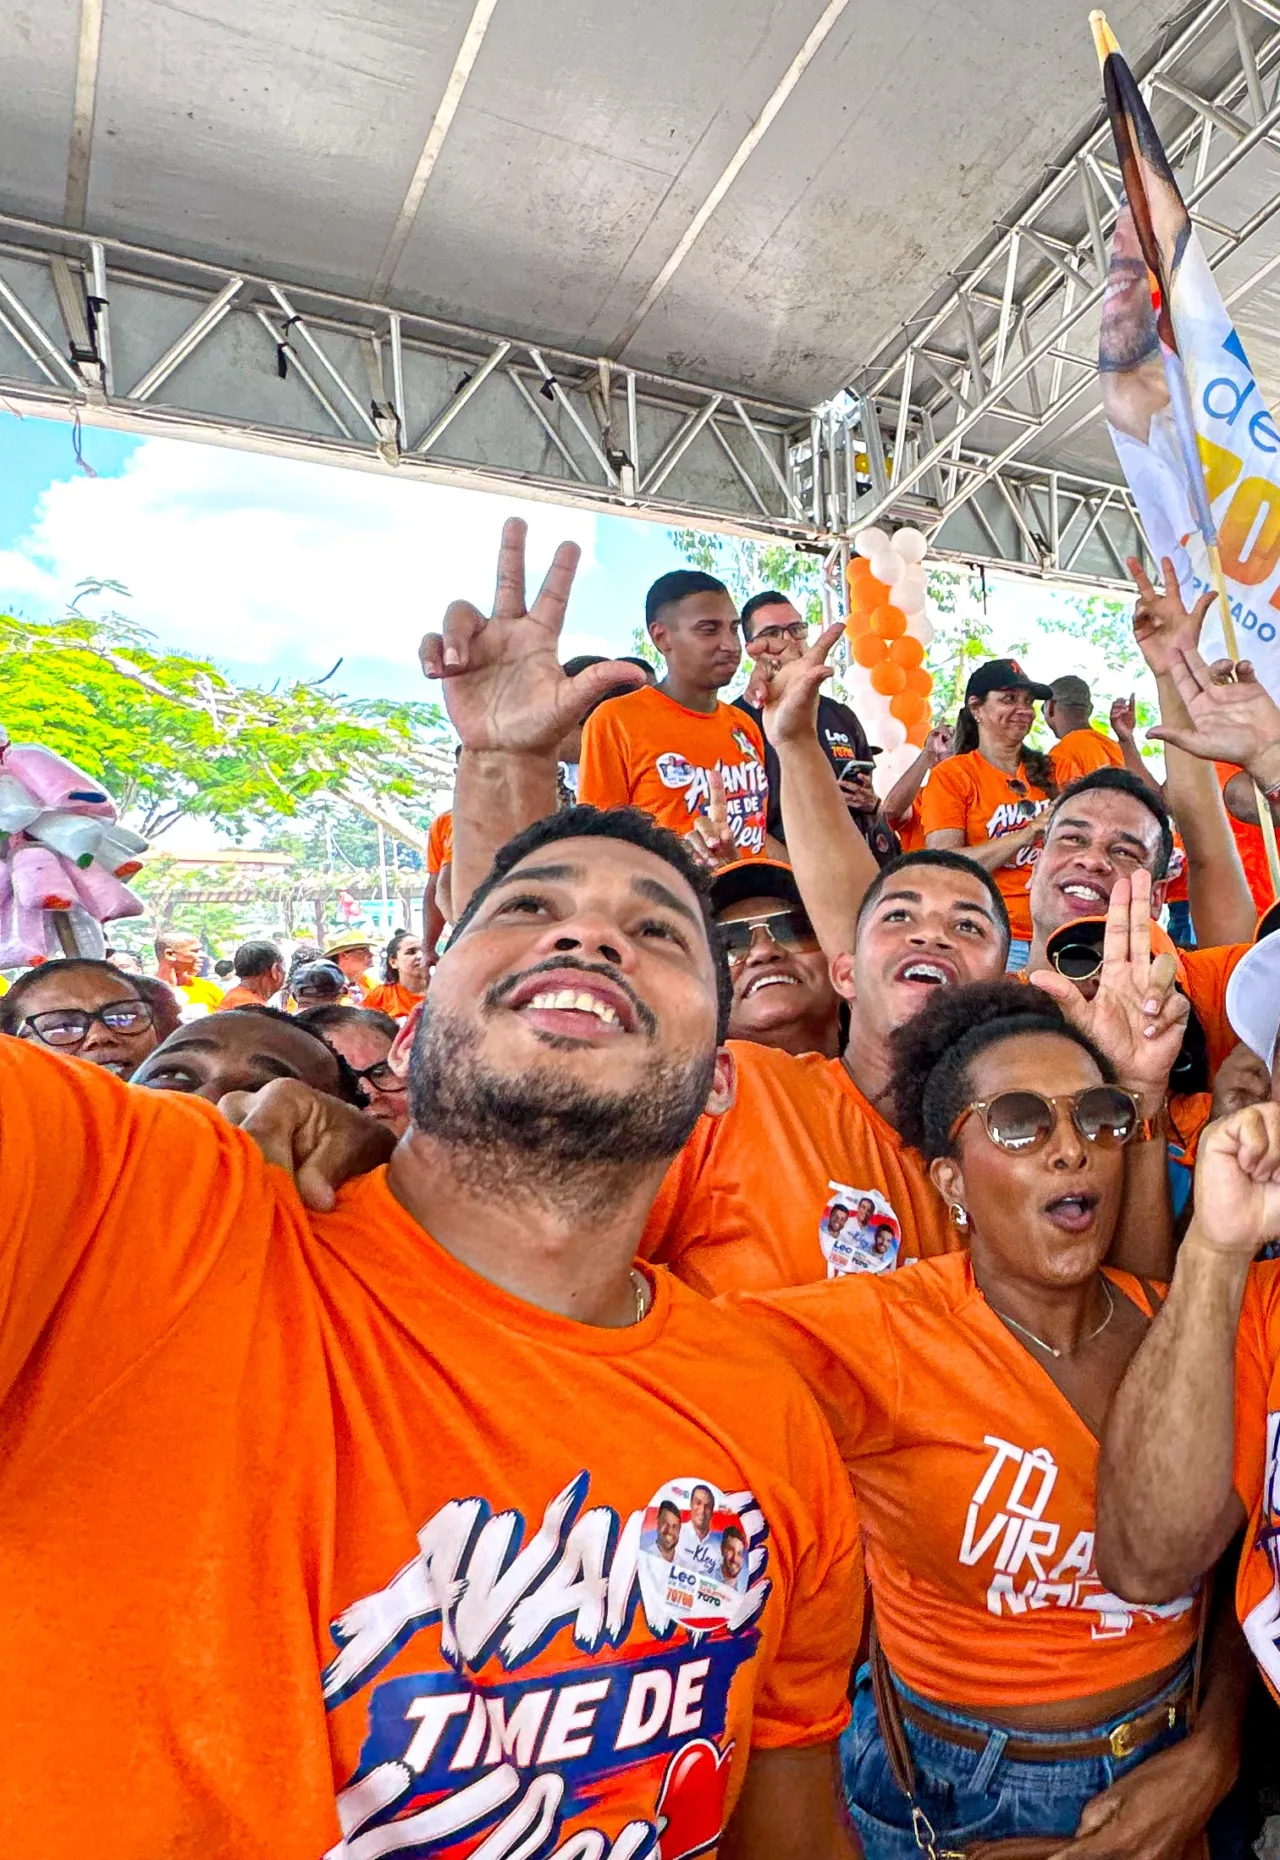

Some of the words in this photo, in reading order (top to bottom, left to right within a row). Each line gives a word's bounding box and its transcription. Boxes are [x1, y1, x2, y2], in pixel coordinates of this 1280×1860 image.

[825, 728, 849, 744] Leo
[684, 758, 769, 816] AANTE
[743, 795, 760, 814] DE
[727, 814, 764, 855] ley
[833, 1240, 853, 1254] Leo
[972, 1434, 1058, 1520] TÔ
[692, 1544, 717, 1574] Kley
[669, 1565, 697, 1586] Leo
[400, 1680, 611, 1775] TIME
[615, 1657, 711, 1752] DE
